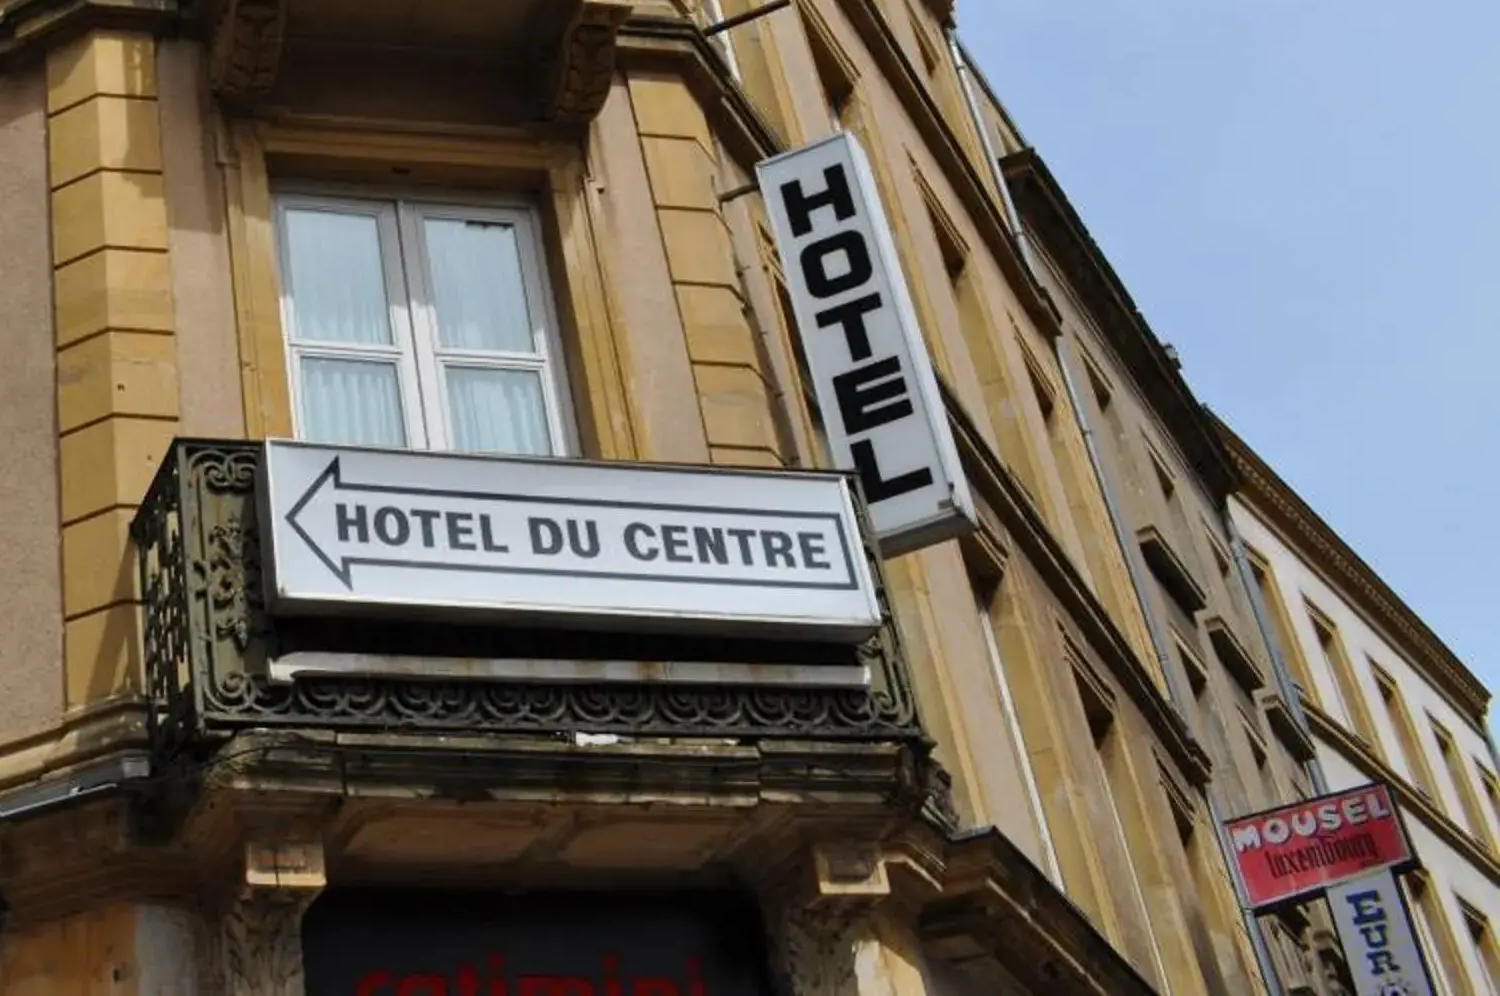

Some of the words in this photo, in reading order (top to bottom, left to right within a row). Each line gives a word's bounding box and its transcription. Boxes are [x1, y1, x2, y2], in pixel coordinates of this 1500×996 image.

[781, 163, 934, 504] HOTEL
[335, 503, 509, 553] HOTEL
[528, 516, 601, 559] DU
[623, 522, 832, 570] CENTRE
[1231, 793, 1390, 853] MOUSEL
